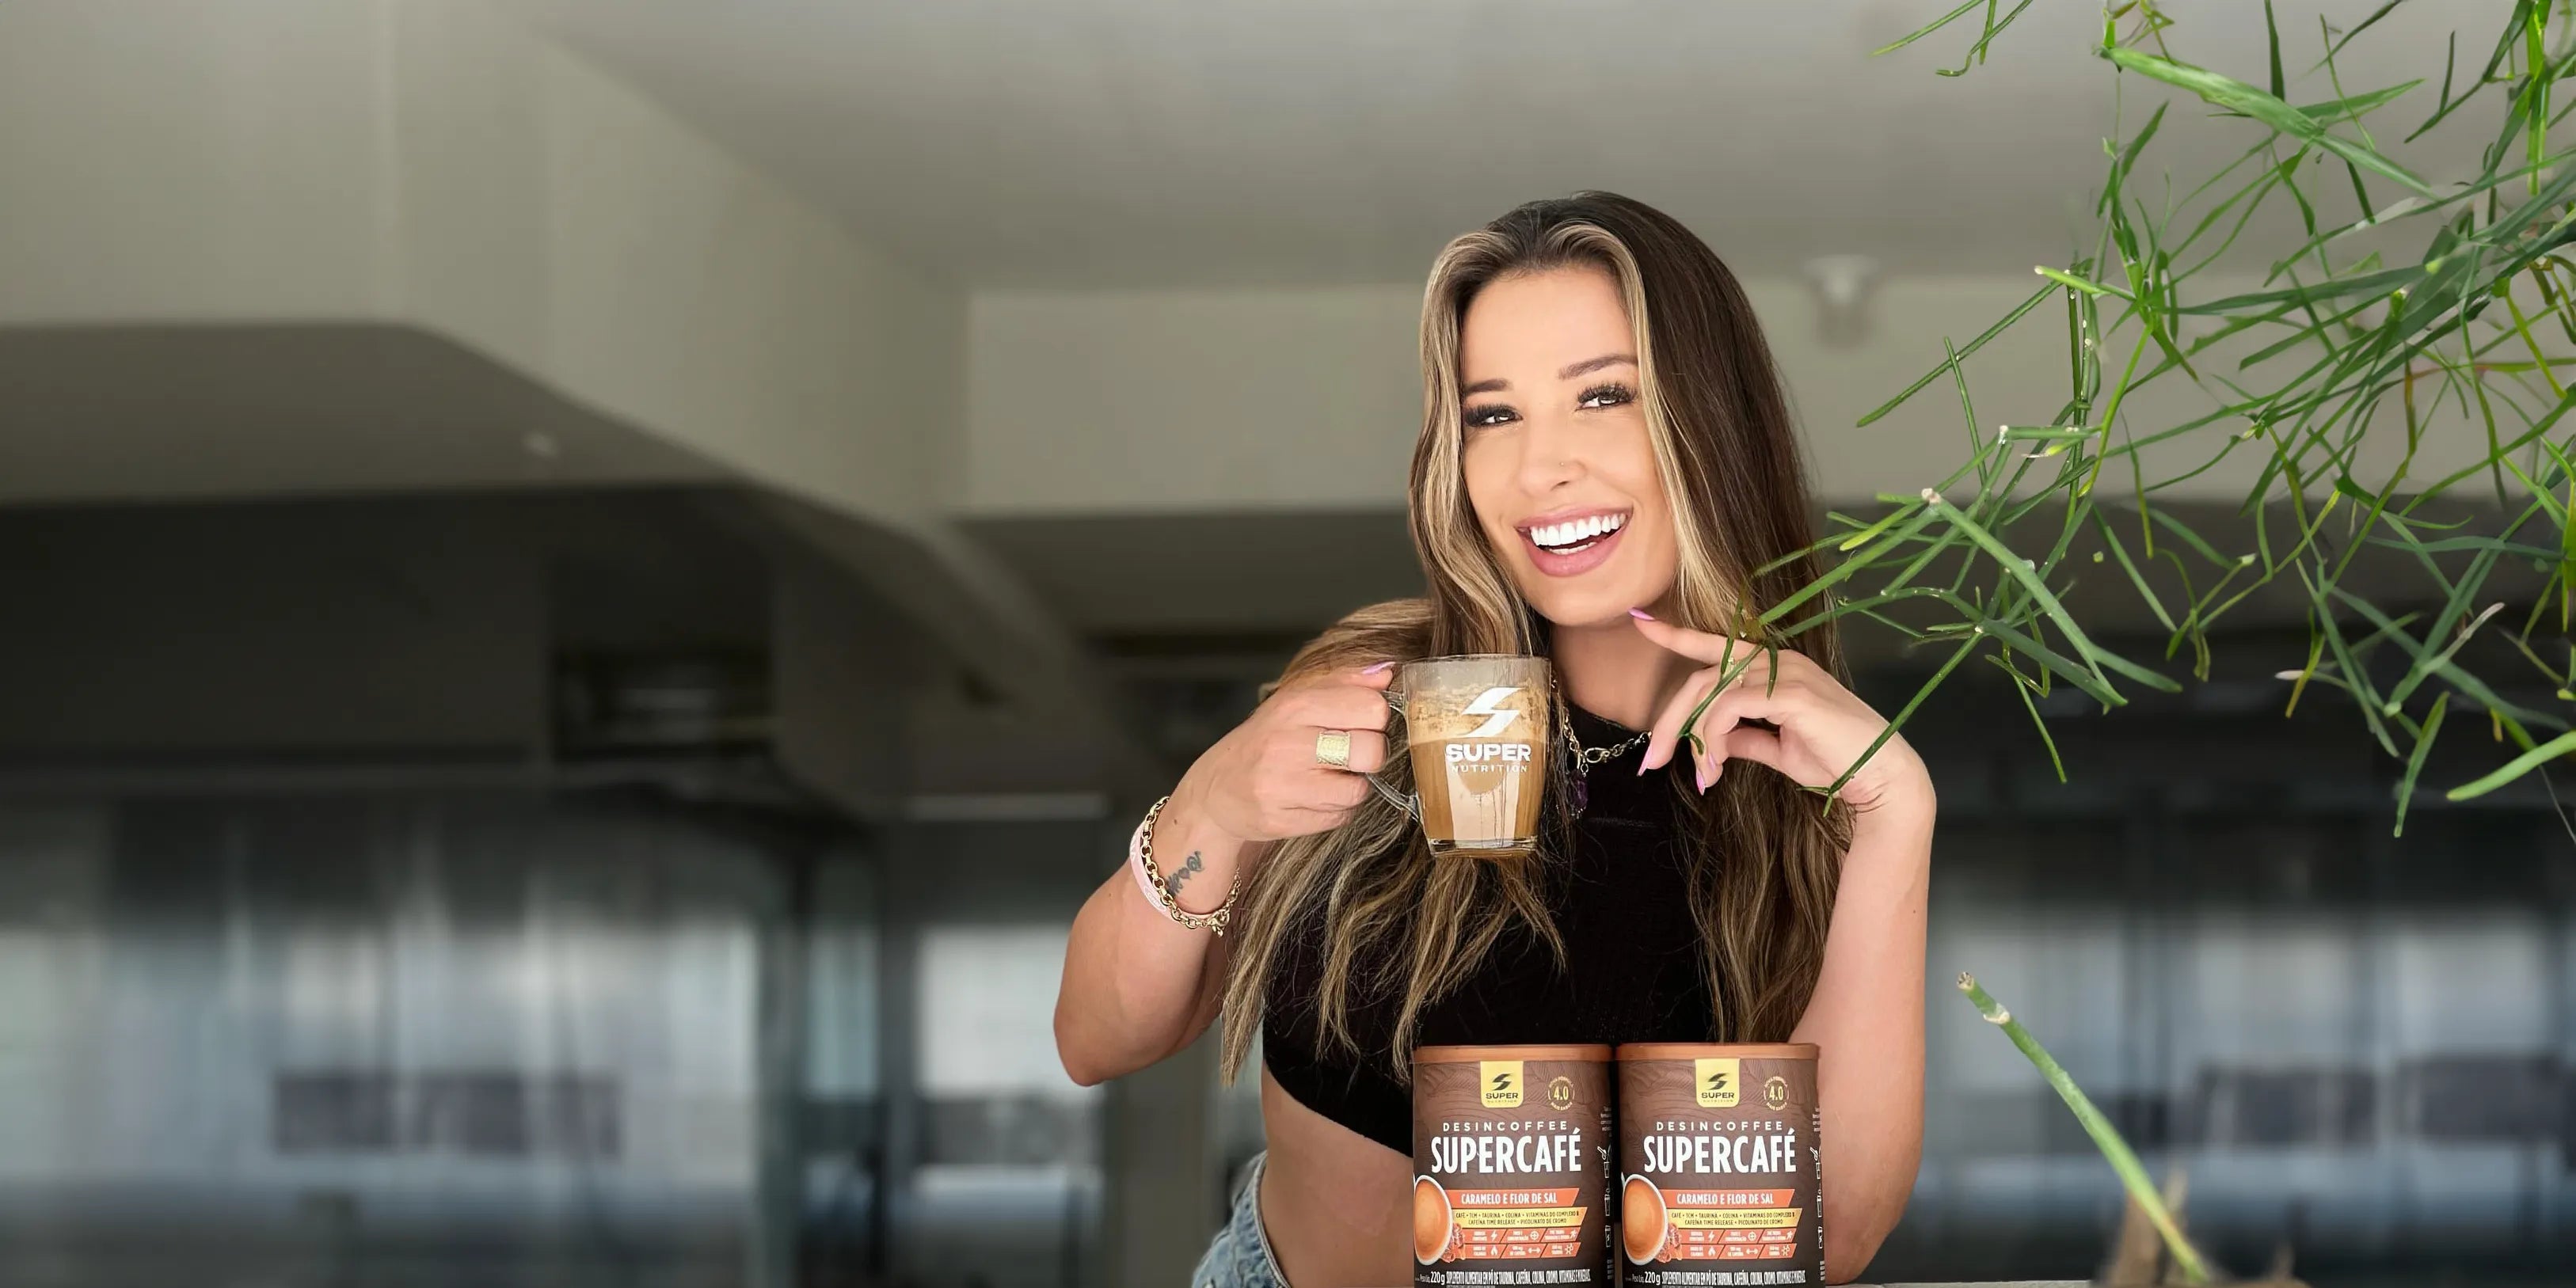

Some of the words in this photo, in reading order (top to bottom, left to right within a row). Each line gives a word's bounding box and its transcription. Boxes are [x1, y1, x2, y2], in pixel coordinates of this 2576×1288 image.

[1445, 743, 1532, 762] SUPER
[1452, 764, 1528, 773] NUTRITION
[1554, 1085, 1569, 1100] 4.0
[1769, 1085, 1783, 1100] 4.0
[1443, 1120, 1567, 1132] DESINCOFFEE
[1656, 1121, 1783, 1131] DESINCOFFEE
[1431, 1127, 1582, 1173] SUPERCAFÉ
[1643, 1127, 1797, 1173] SUPERCAFÉ
[1461, 1193, 1501, 1204] CARAMELO
[1503, 1193, 1508, 1204] E
[1510, 1193, 1530, 1204] FLOR
[1532, 1193, 1542, 1204] DE
[1543, 1192, 1557, 1204] SAL
[1676, 1193, 1718, 1205] CARAMELO
[1720, 1194, 1725, 1204] E
[1727, 1193, 1747, 1204] FLOR
[1748, 1193, 1760, 1204] DE
[1760, 1193, 1774, 1204] SAL
